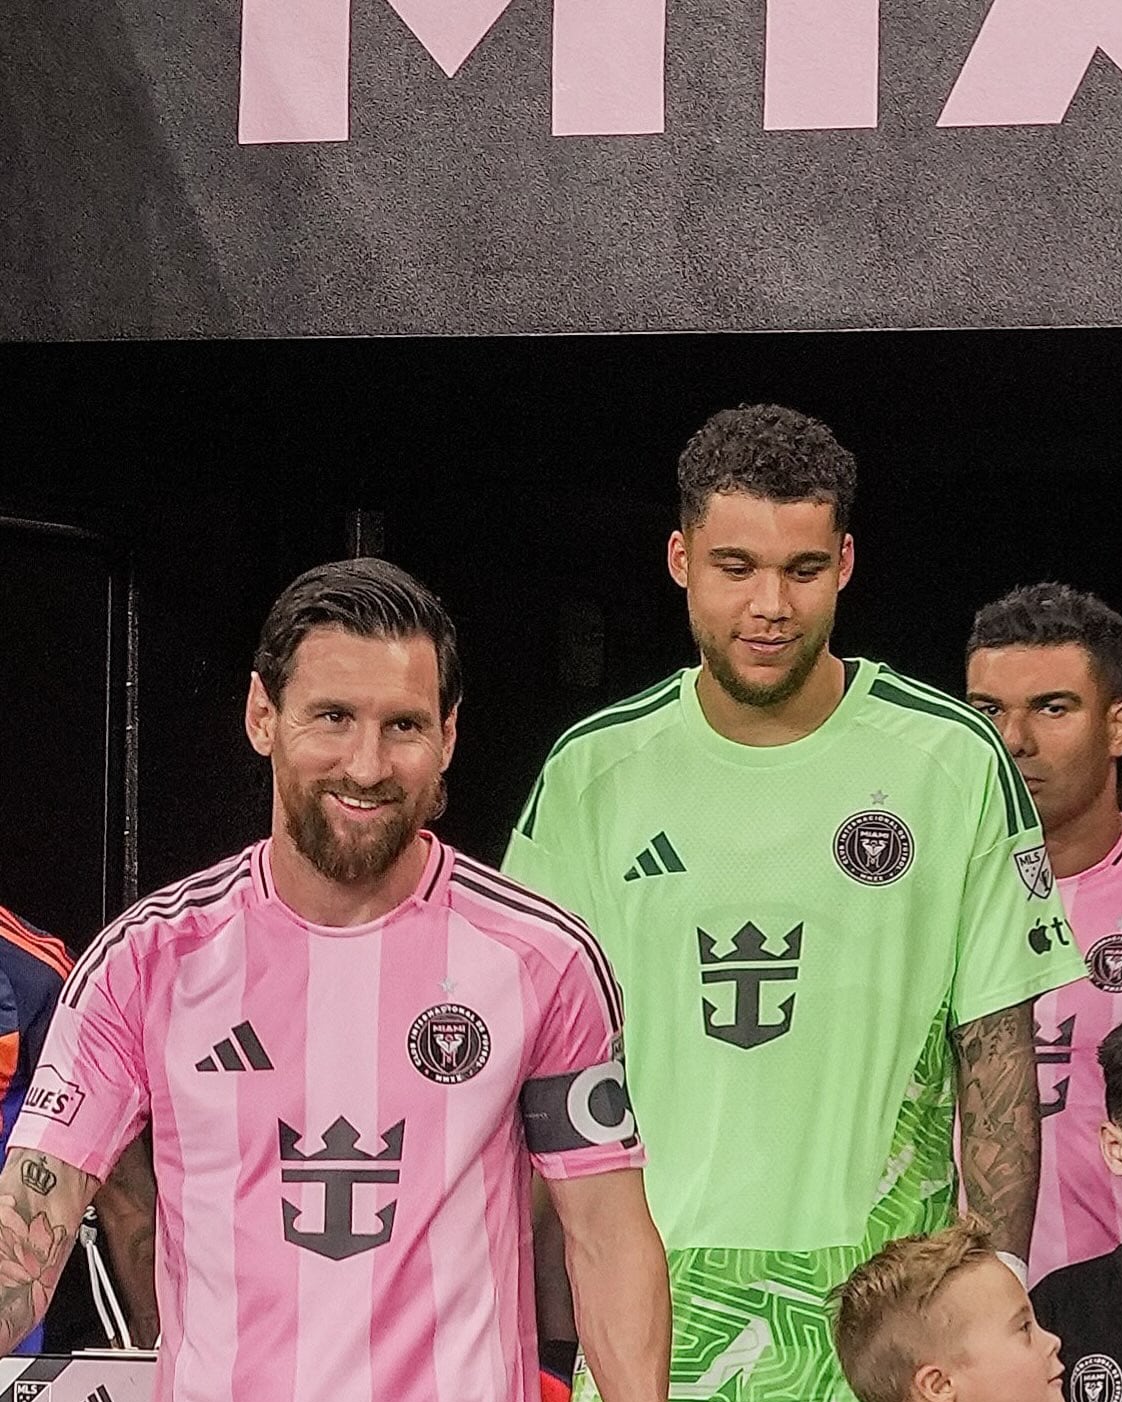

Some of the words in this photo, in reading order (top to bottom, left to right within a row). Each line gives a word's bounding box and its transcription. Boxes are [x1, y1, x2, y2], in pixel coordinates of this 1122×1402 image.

[1019, 851, 1041, 866] MLS
[432, 1024, 466, 1033] MIAMI
[567, 1060, 635, 1145] C
[17, 1384, 39, 1395] MLS
